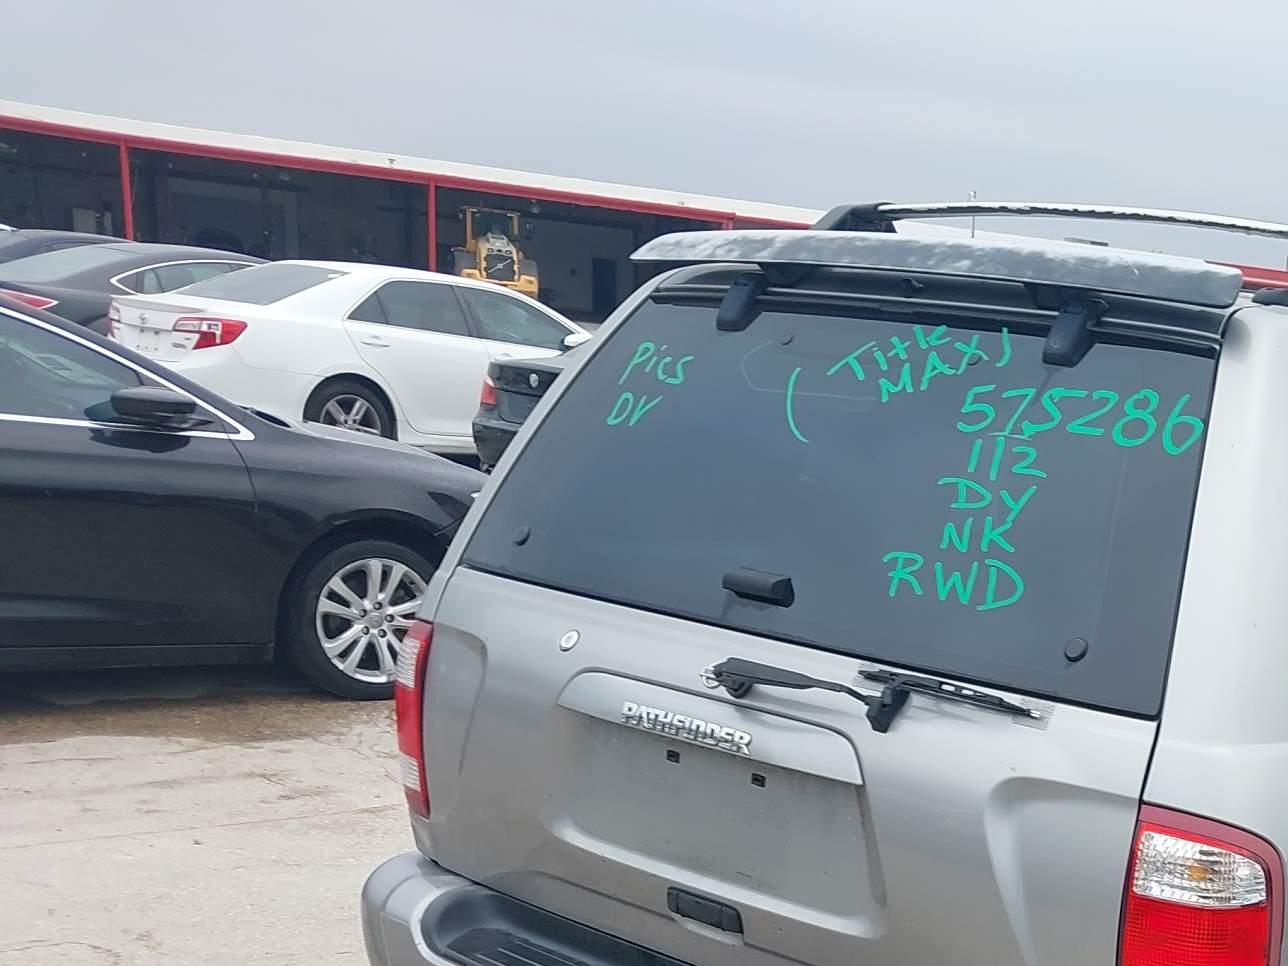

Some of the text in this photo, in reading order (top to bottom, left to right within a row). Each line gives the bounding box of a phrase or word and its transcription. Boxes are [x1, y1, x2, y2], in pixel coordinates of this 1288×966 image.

[618, 341, 695, 385] Pics
[956, 384, 1206, 457] 575286
[966, 436, 1049, 482] 112
[937, 476, 1038, 522] DY
[938, 519, 1017, 554] NK
[882, 549, 1026, 612] RWD
[619, 700, 753, 756] PATHFINDER
